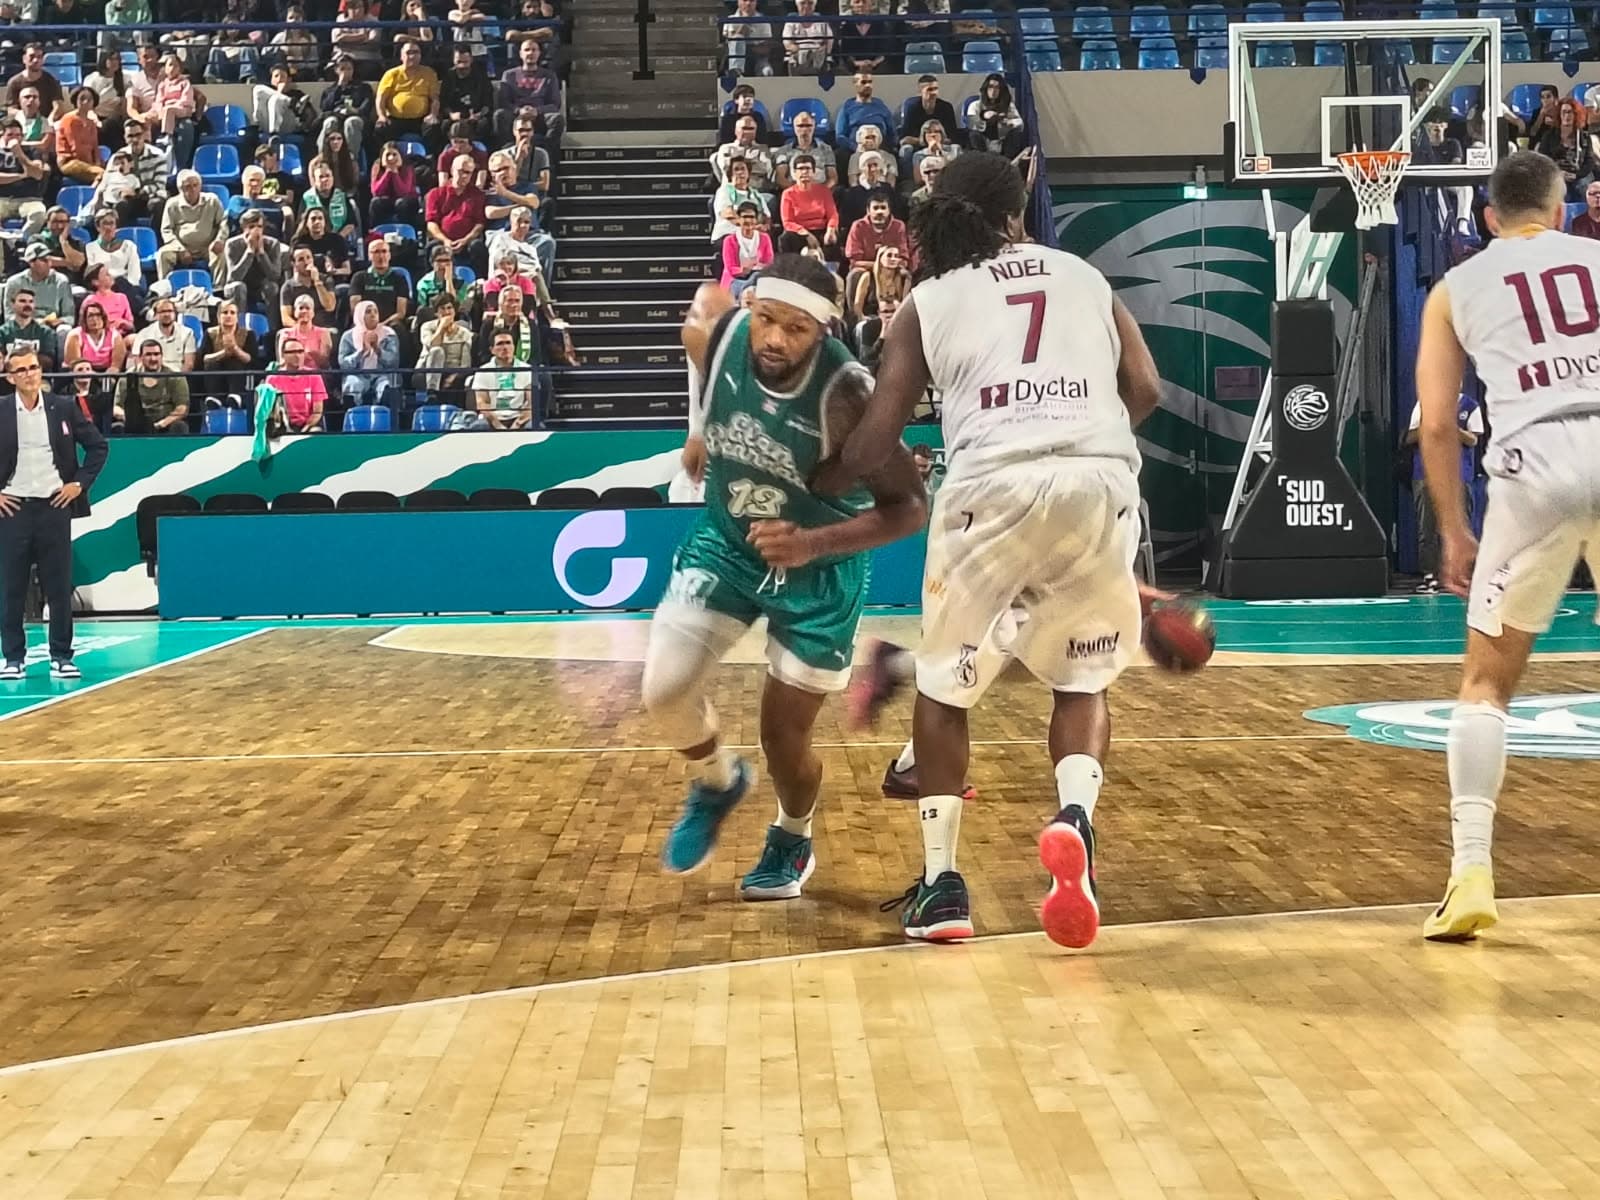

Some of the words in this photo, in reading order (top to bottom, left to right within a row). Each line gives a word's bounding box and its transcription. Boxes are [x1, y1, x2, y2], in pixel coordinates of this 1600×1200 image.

[1503, 264, 1600, 345] 10
[1005, 290, 1046, 364] 7
[1015, 376, 1088, 405] Dyctal
[1286, 480, 1325, 502] SUD
[1286, 504, 1344, 526] OUEST
